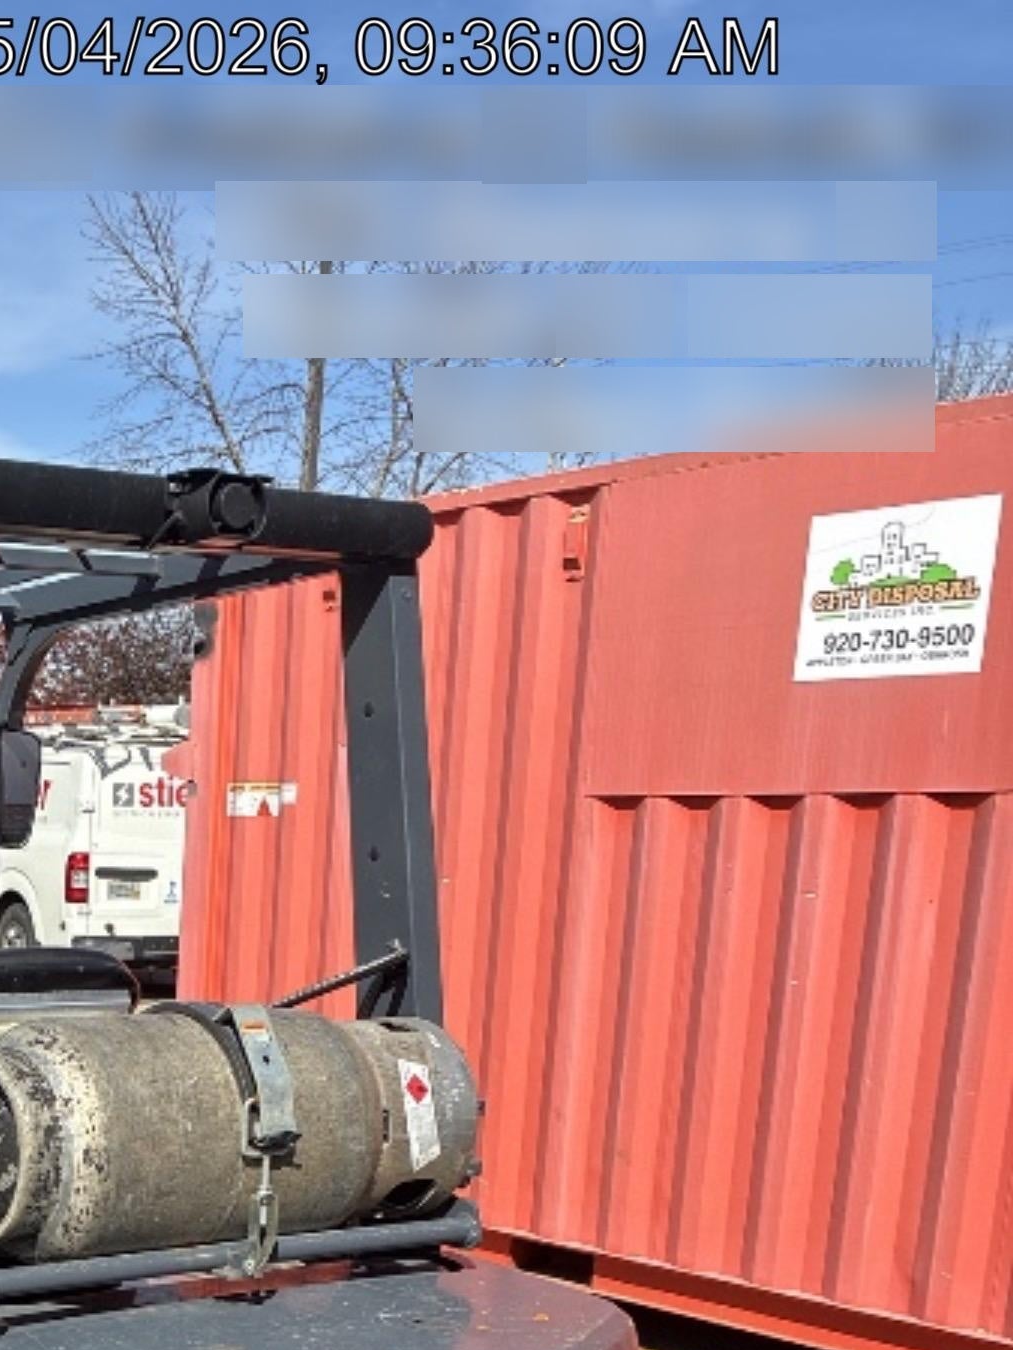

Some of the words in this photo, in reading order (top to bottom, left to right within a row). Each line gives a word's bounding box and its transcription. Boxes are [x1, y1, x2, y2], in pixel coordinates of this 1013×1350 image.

[811, 588, 864, 612] CITY
[867, 576, 980, 609] DISPOSAL
[823, 623, 975, 655] 920-730-9500
